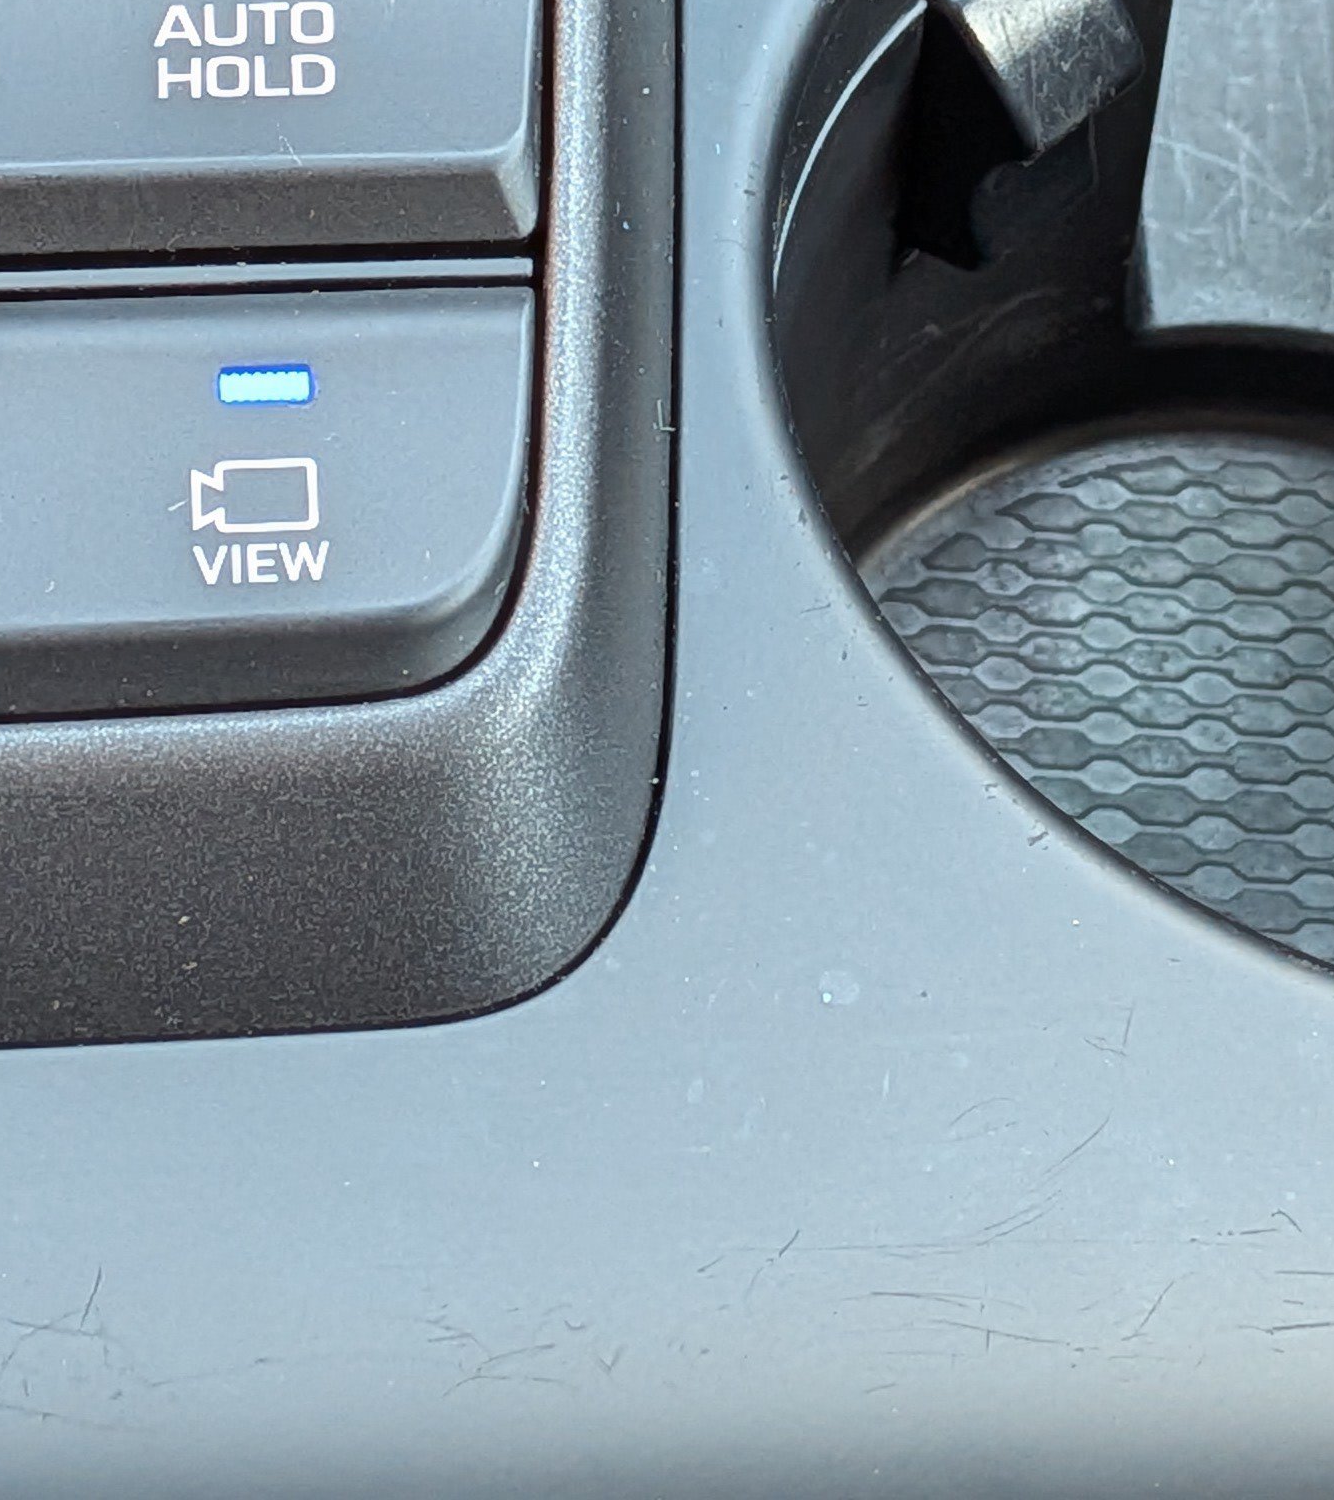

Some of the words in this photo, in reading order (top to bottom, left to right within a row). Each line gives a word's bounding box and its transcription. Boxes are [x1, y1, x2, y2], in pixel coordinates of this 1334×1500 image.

[153, 1, 335, 47] AUTO
[157, 53, 336, 99] HOLD
[192, 540, 330, 585] VIEW
